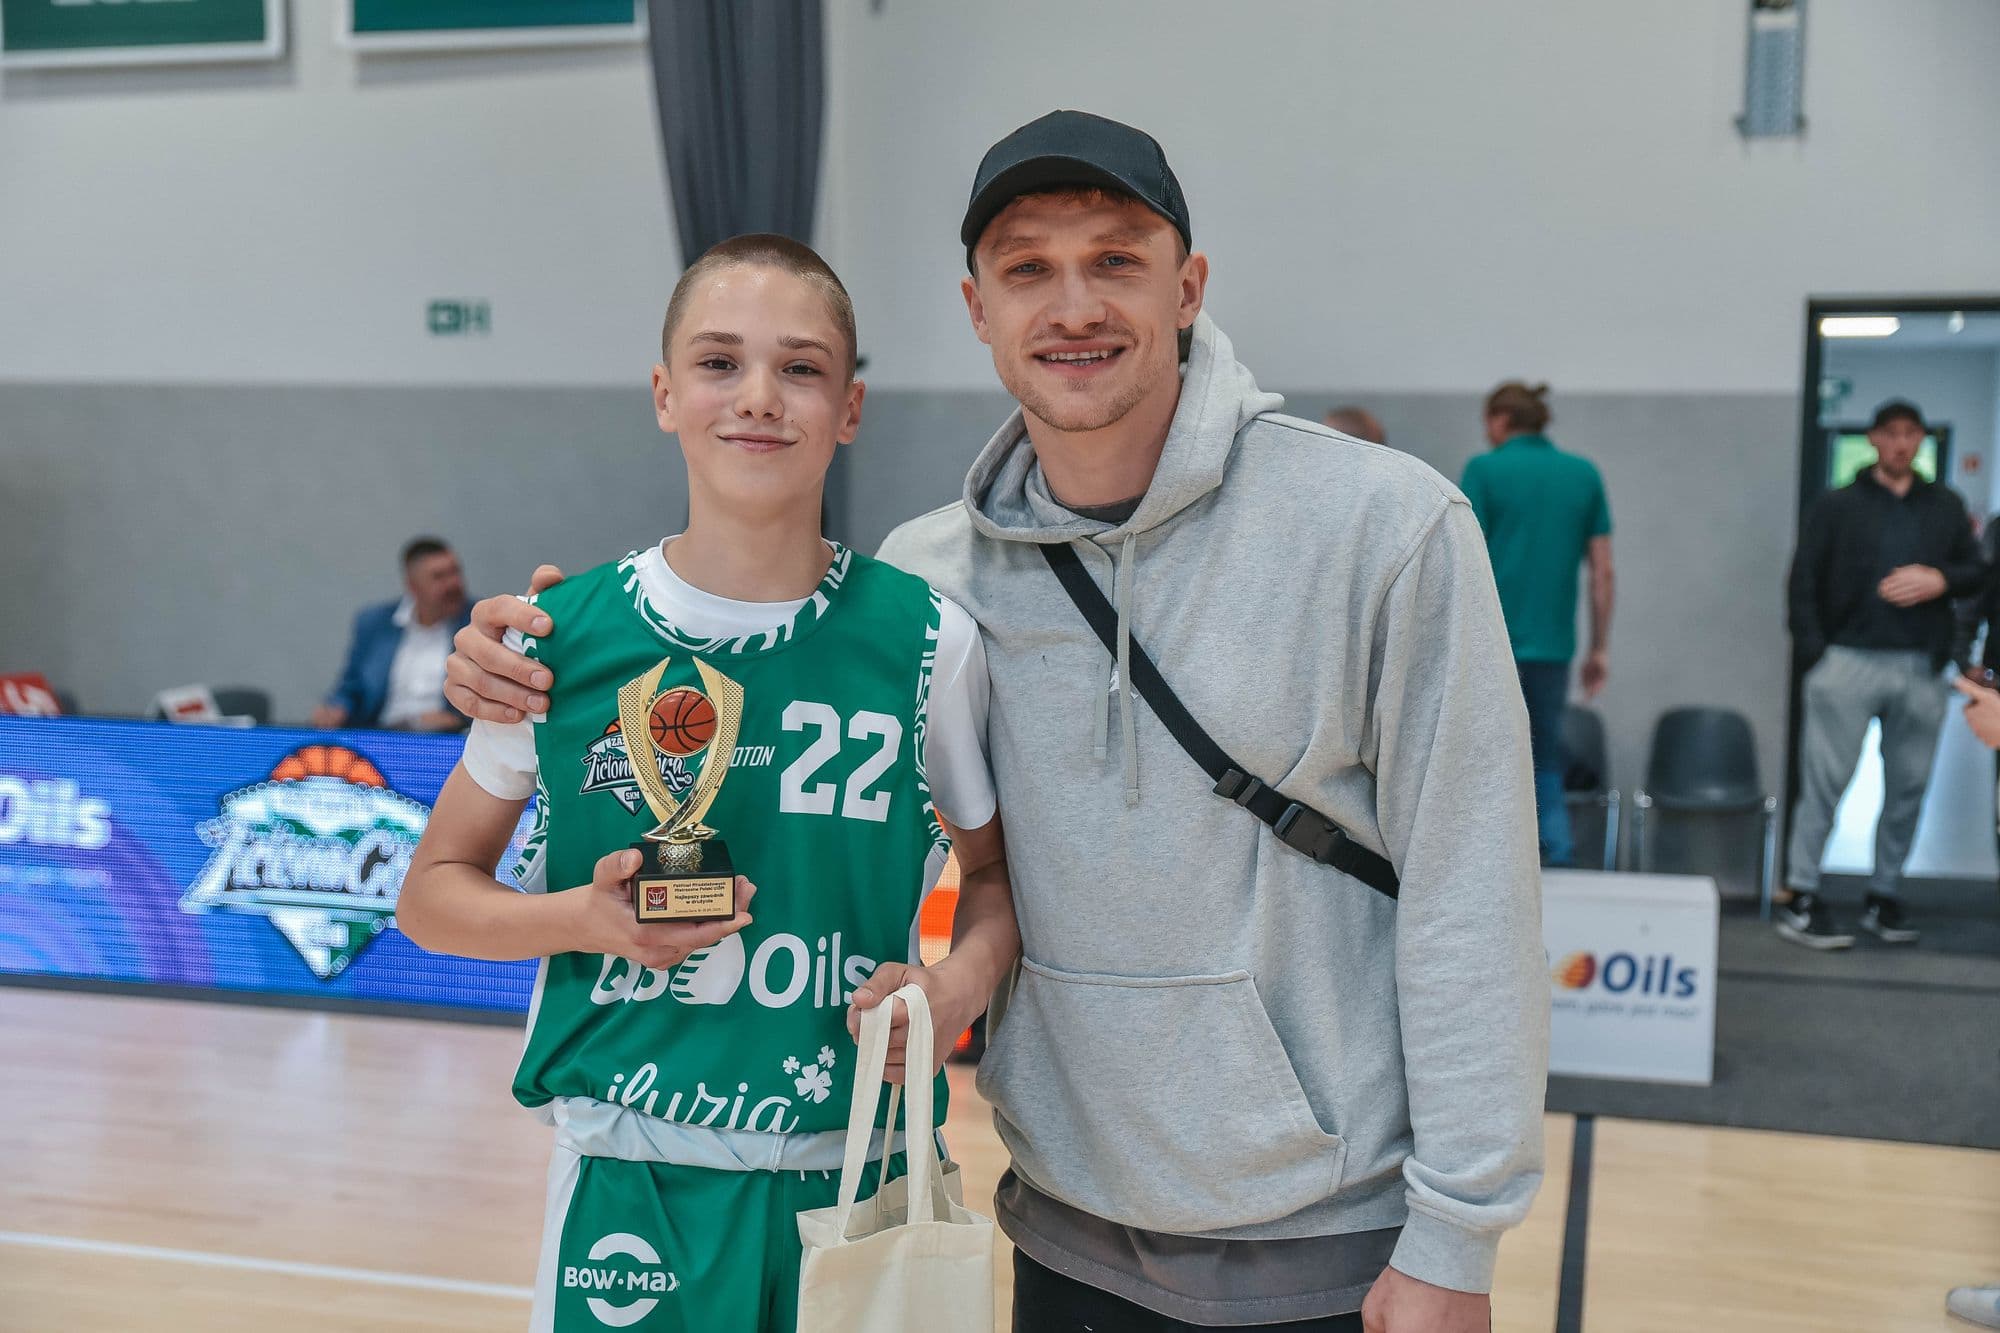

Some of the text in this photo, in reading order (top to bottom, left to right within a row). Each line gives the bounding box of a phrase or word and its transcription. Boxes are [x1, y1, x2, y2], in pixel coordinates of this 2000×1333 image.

[729, 745, 776, 767] OTON
[779, 700, 903, 822] 22
[625, 791, 640, 801] SKM
[749, 931, 877, 1008] Oils
[1602, 951, 1697, 999] Oils
